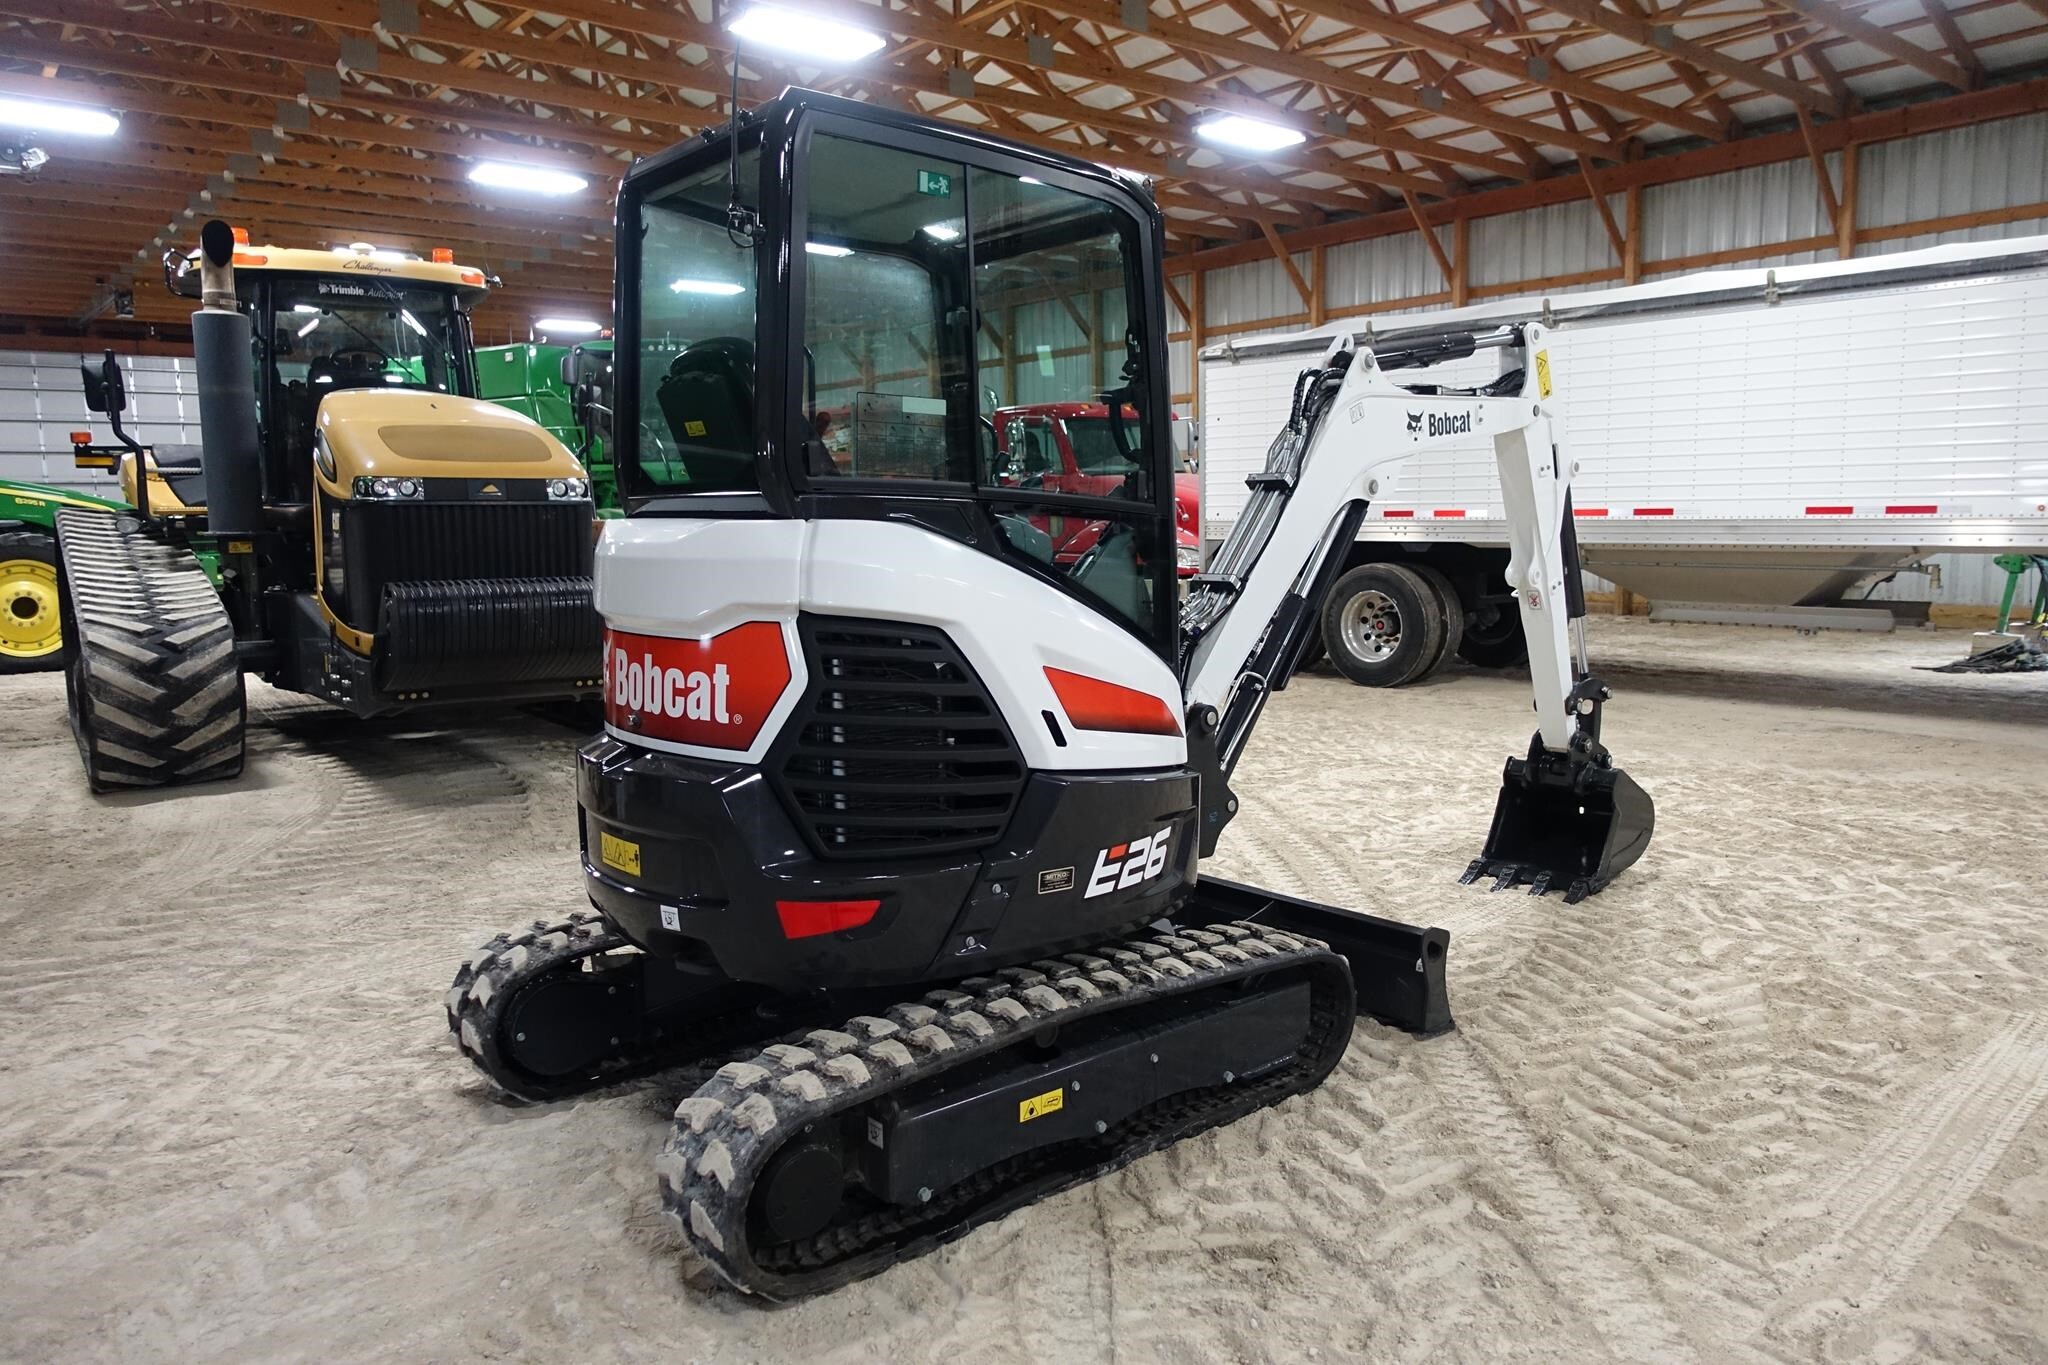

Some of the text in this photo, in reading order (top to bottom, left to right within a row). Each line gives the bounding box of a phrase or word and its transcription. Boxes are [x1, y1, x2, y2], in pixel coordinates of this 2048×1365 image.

[342, 260, 392, 274] Challenger
[329, 284, 365, 296] Trimble
[1428, 410, 1471, 437] Bobcat
[615, 648, 730, 724] Bobcat
[1084, 826, 1171, 898] E26
